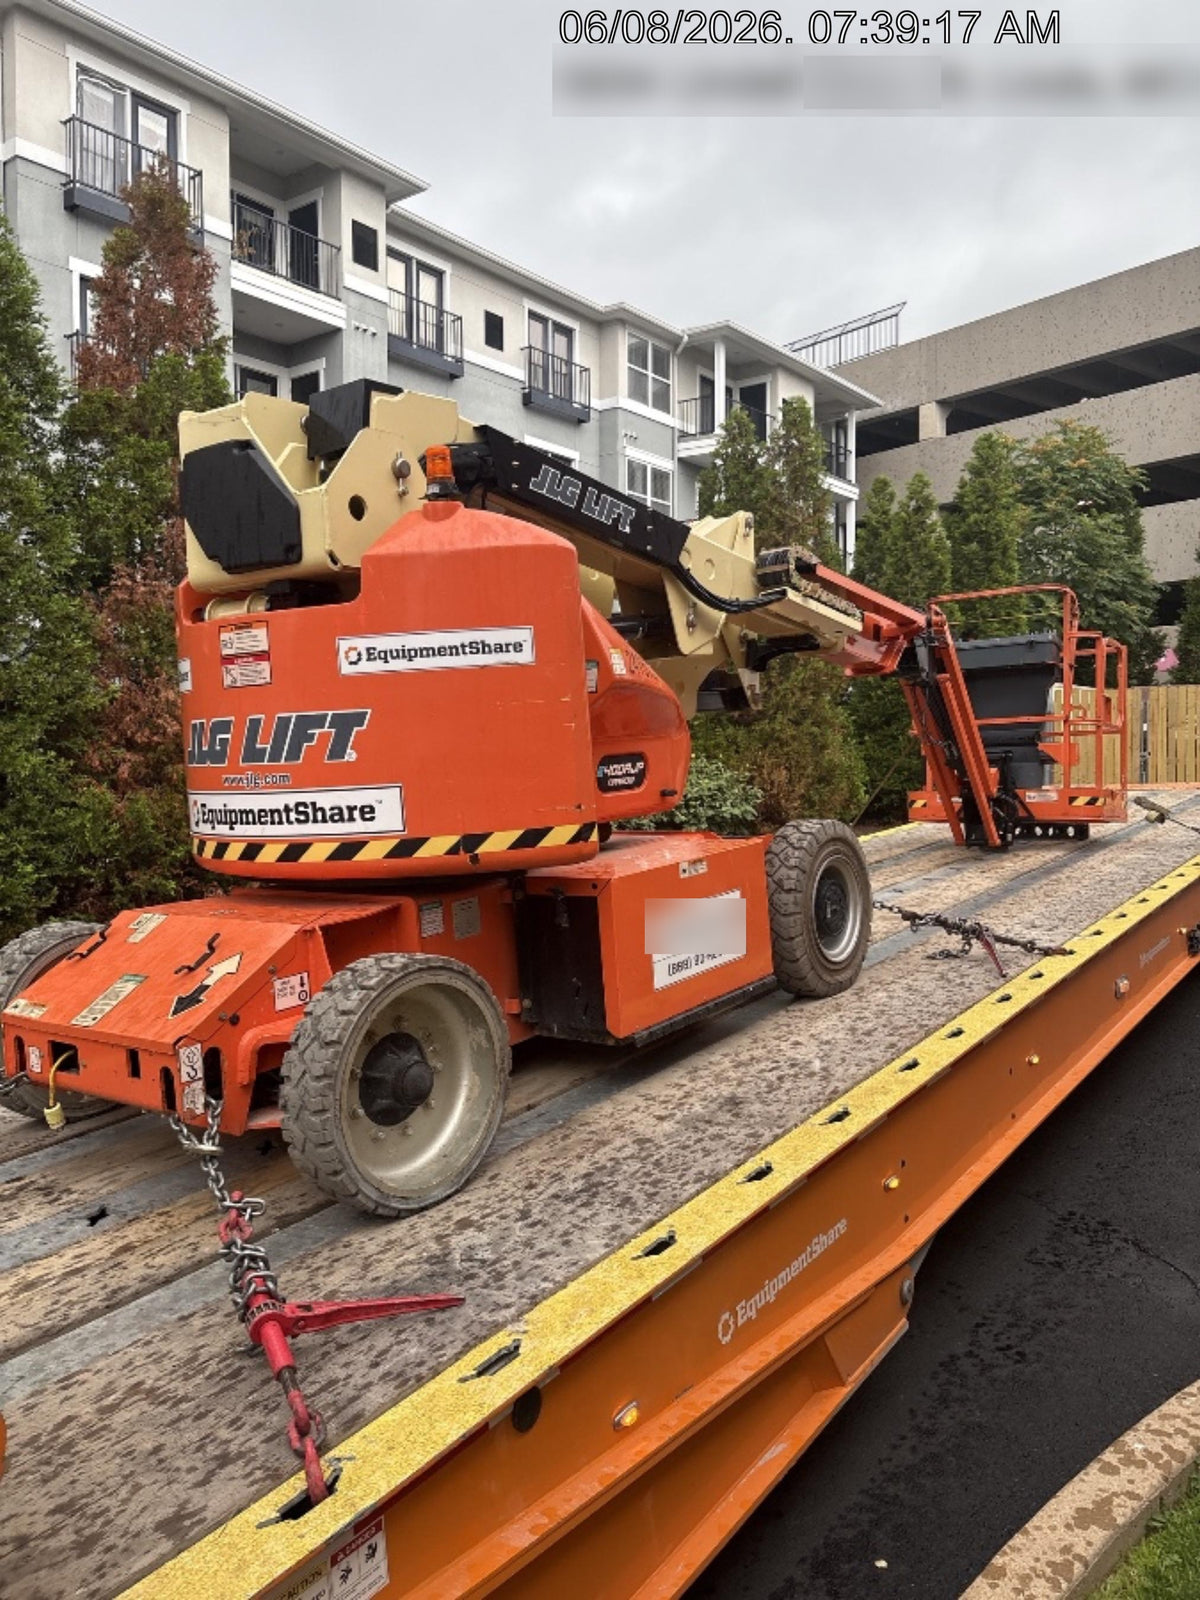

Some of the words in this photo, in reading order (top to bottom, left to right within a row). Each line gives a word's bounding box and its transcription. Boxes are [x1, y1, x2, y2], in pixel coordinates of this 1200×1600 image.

[529, 464, 582, 509] JLG
[581, 486, 636, 534] LIFT
[365, 639, 524, 664] EquipmentShare
[240, 708, 372, 766] LIFT
[222, 771, 292, 788] www.jlg.com
[200, 801, 377, 831] EquipmentShare
[736, 1217, 848, 1328] EquipmentShare
